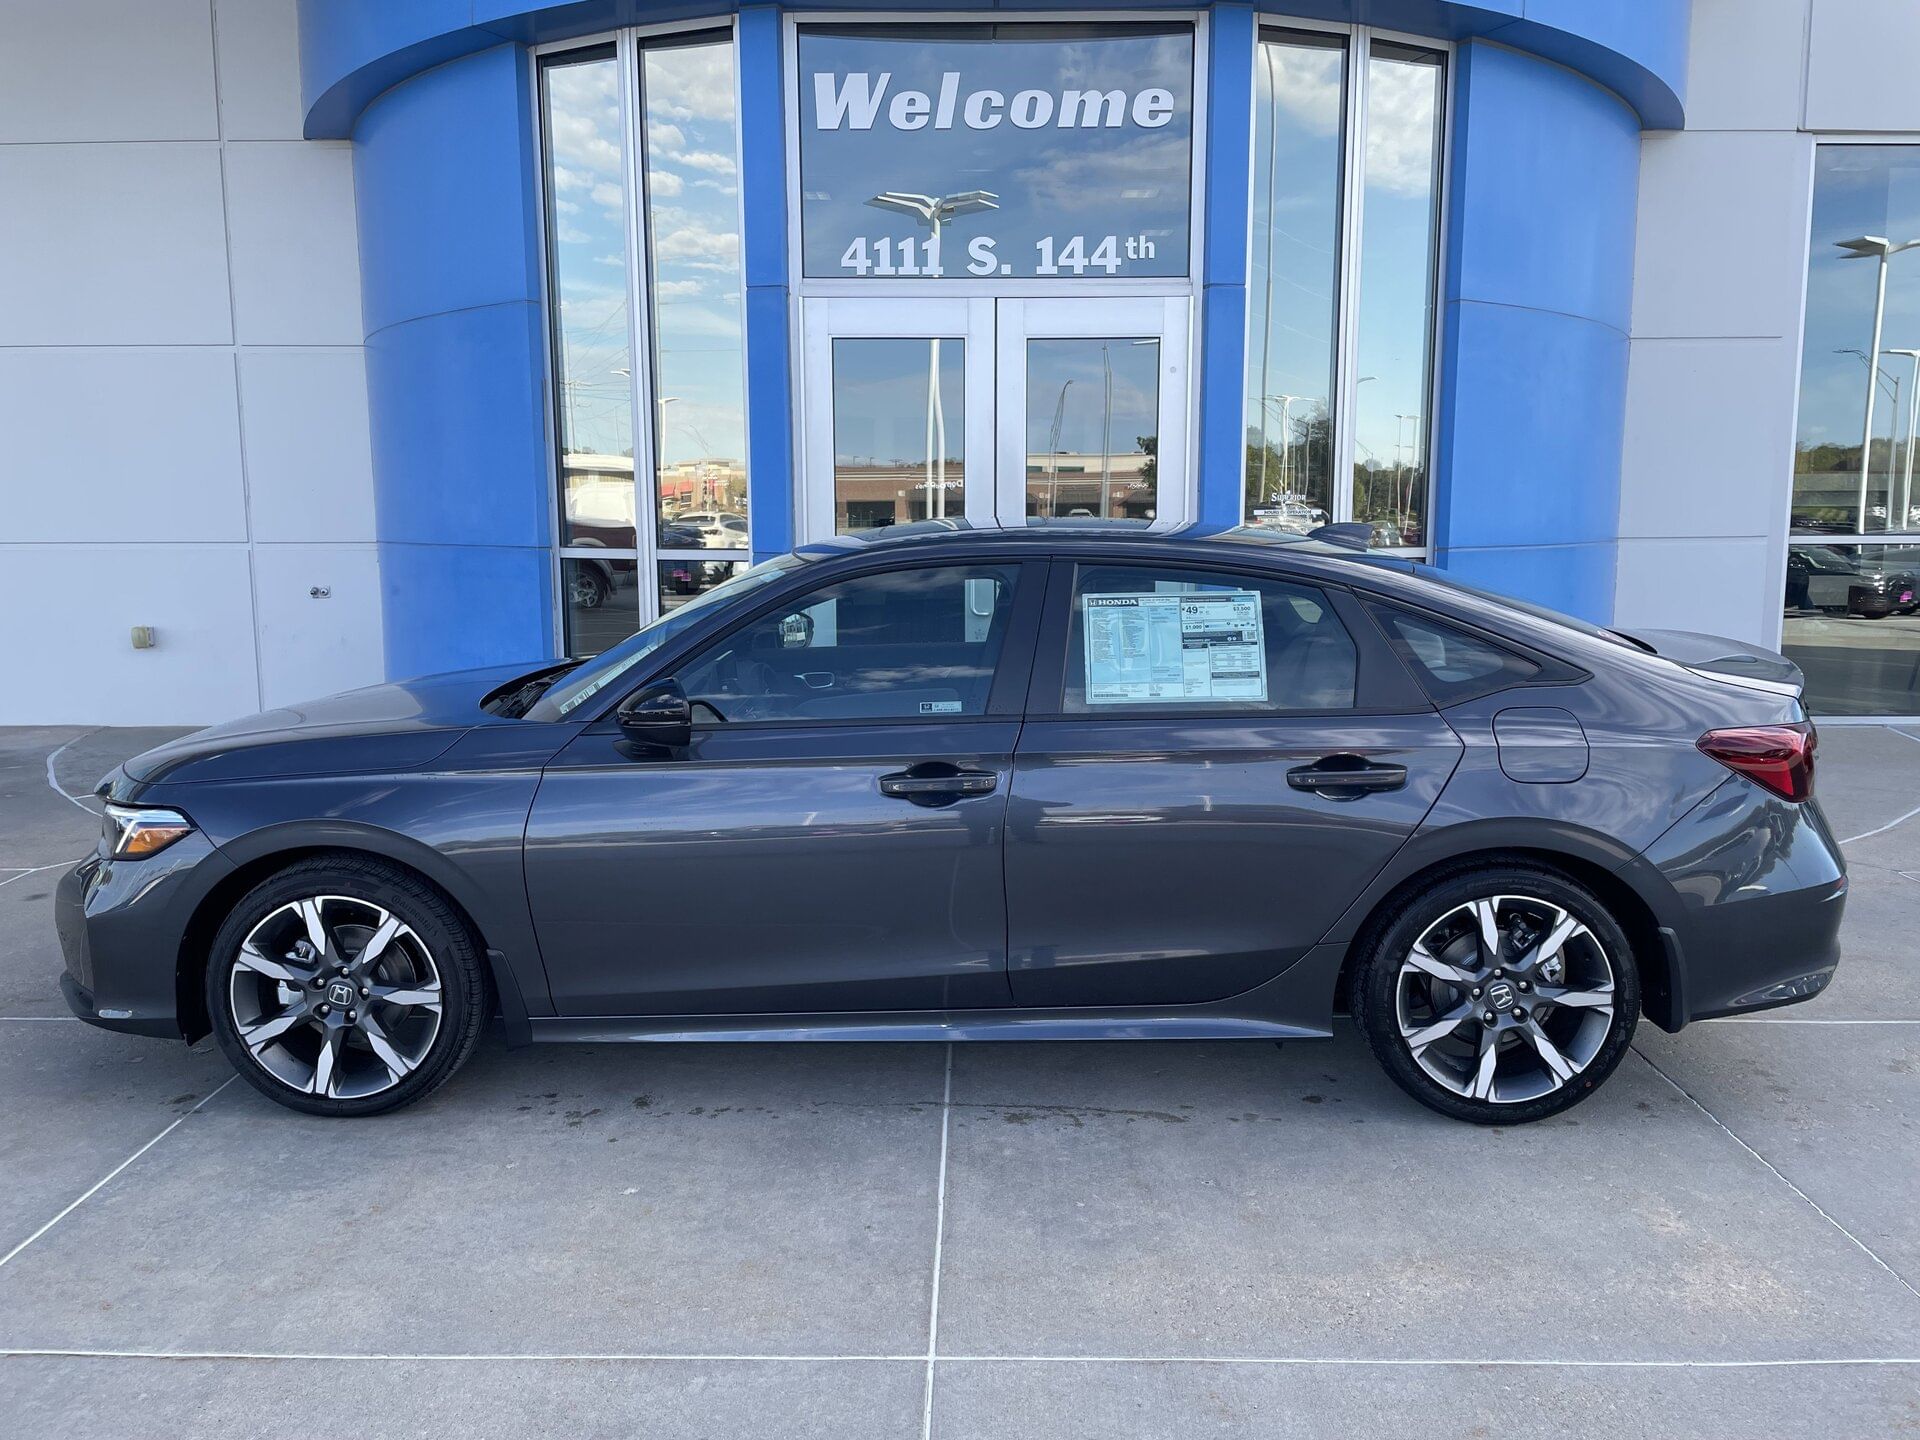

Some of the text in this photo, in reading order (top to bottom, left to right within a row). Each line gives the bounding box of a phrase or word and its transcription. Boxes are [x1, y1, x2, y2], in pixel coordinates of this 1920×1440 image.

[814, 72, 1175, 131] Welcome
[840, 236, 944, 276] 4111
[966, 235, 1012, 276] S.
[1186, 606, 1198, 614] 49
